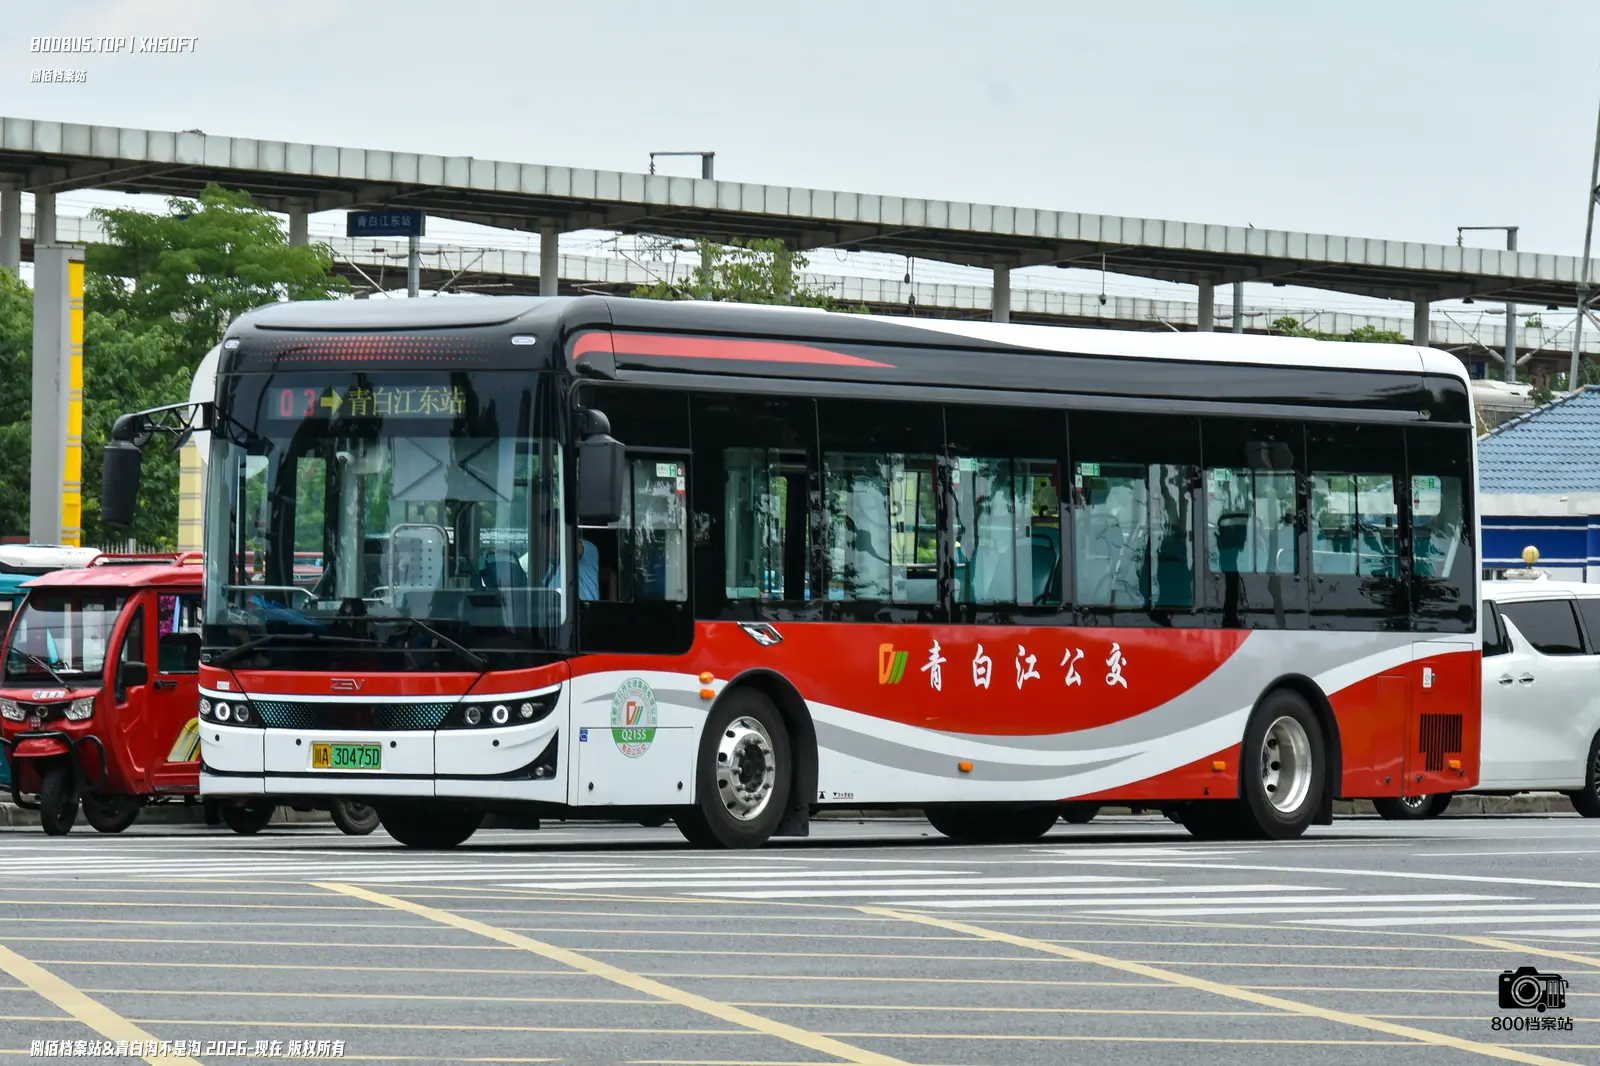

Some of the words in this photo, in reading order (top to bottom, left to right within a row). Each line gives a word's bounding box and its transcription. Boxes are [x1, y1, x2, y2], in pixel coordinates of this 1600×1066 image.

[357, 215, 411, 228] 青白江东站
[348, 386, 466, 416] 青白江东站
[920, 639, 1128, 692] 青白江公交
